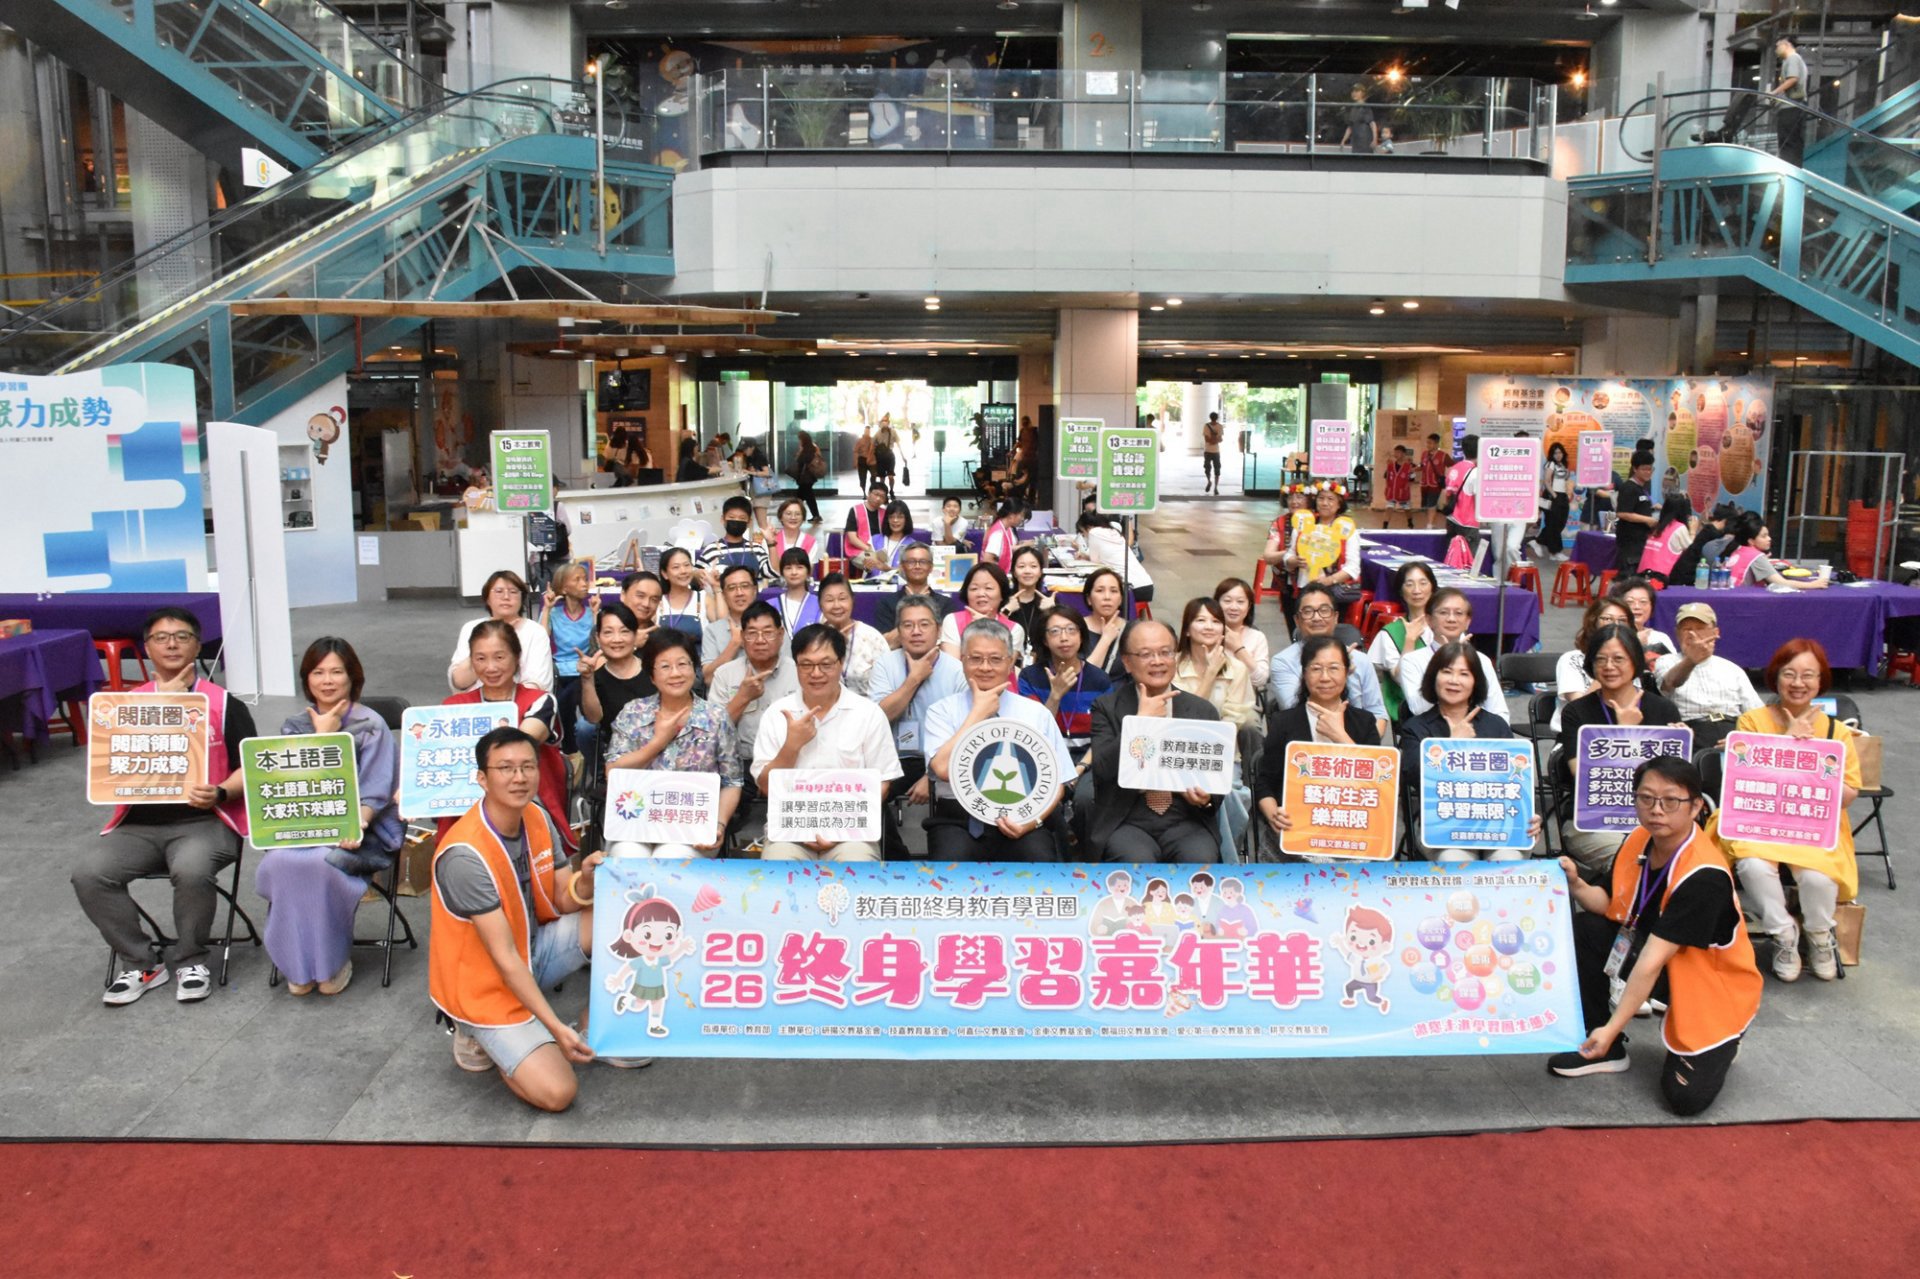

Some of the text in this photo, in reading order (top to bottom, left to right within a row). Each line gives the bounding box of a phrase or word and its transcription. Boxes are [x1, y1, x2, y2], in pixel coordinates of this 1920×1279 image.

[502, 440, 512, 450] 15
[1109, 438, 1150, 448] 13 本土教育
[1489, 447, 1530, 457] 12 多元教育
[117, 706, 183, 726] 閱讀圈
[429, 716, 492, 739] 永續圈
[110, 734, 189, 753] 閱讀領動
[1162, 740, 1225, 756] 教育基金會
[110, 755, 189, 775] 聚力成勢
[256, 746, 342, 771] 本土語言
[958, 727, 1052, 805] MINISTRY OF EDUCATION
[1160, 756, 1224, 772] 終身學習圈
[1311, 756, 1375, 780] 藝術圈
[1446, 751, 1509, 772] 科普圈
[1752, 746, 1819, 771] 媒體圈
[260, 779, 345, 799] 本土語言上時行
[649, 790, 710, 807] 七圈攜手
[1303, 784, 1379, 808] 藝術生活
[1436, 781, 1521, 799] 科普創玩家
[262, 800, 348, 820] 大家共下來講客
[647, 808, 709, 825] 樂學跨界
[781, 800, 869, 813] 讓學習成為習慣
[971, 796, 1033, 820] 教育部
[781, 816, 868, 829] 讓知識成為力量
[1311, 807, 1368, 829] 樂無限
[855, 896, 1078, 918] 教育部終身教育學習圈
[705, 933, 764, 962] 20
[776, 931, 1321, 1006] 終身學習嘉年華
[704, 974, 763, 1004] 26
